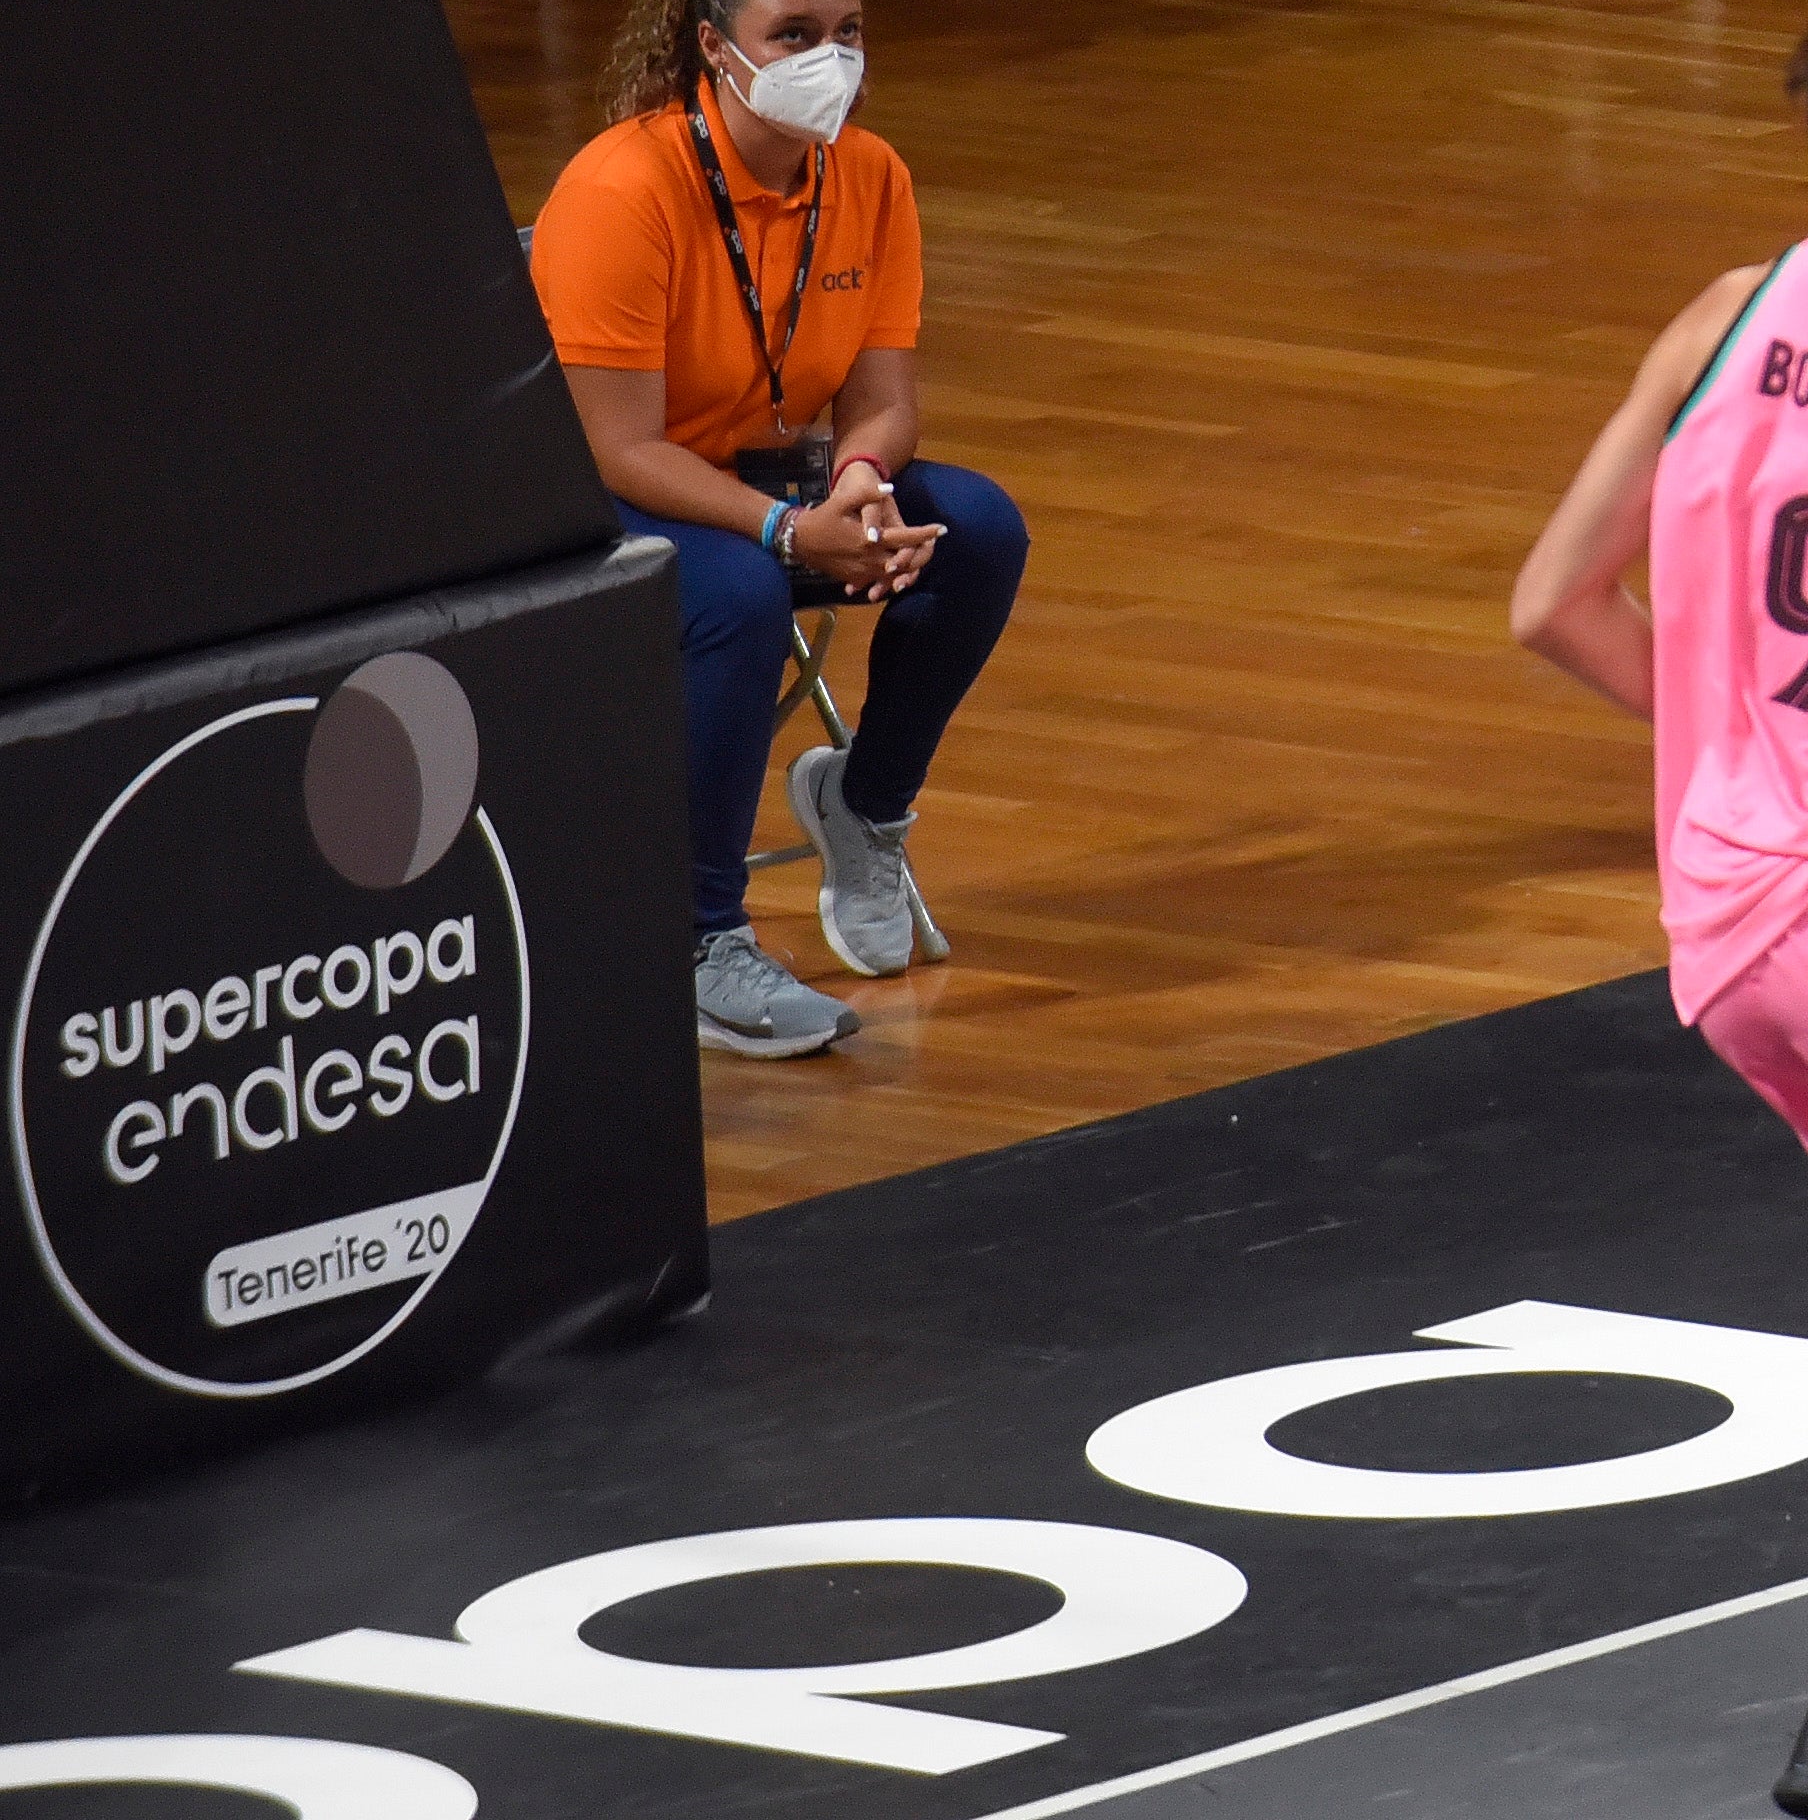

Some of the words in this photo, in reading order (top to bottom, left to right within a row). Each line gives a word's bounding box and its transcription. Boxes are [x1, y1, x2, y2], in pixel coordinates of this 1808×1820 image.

[60, 914, 478, 1079] supercopa
[103, 1013, 483, 1184] endesa
[216, 1234, 388, 1312] Tenerife
